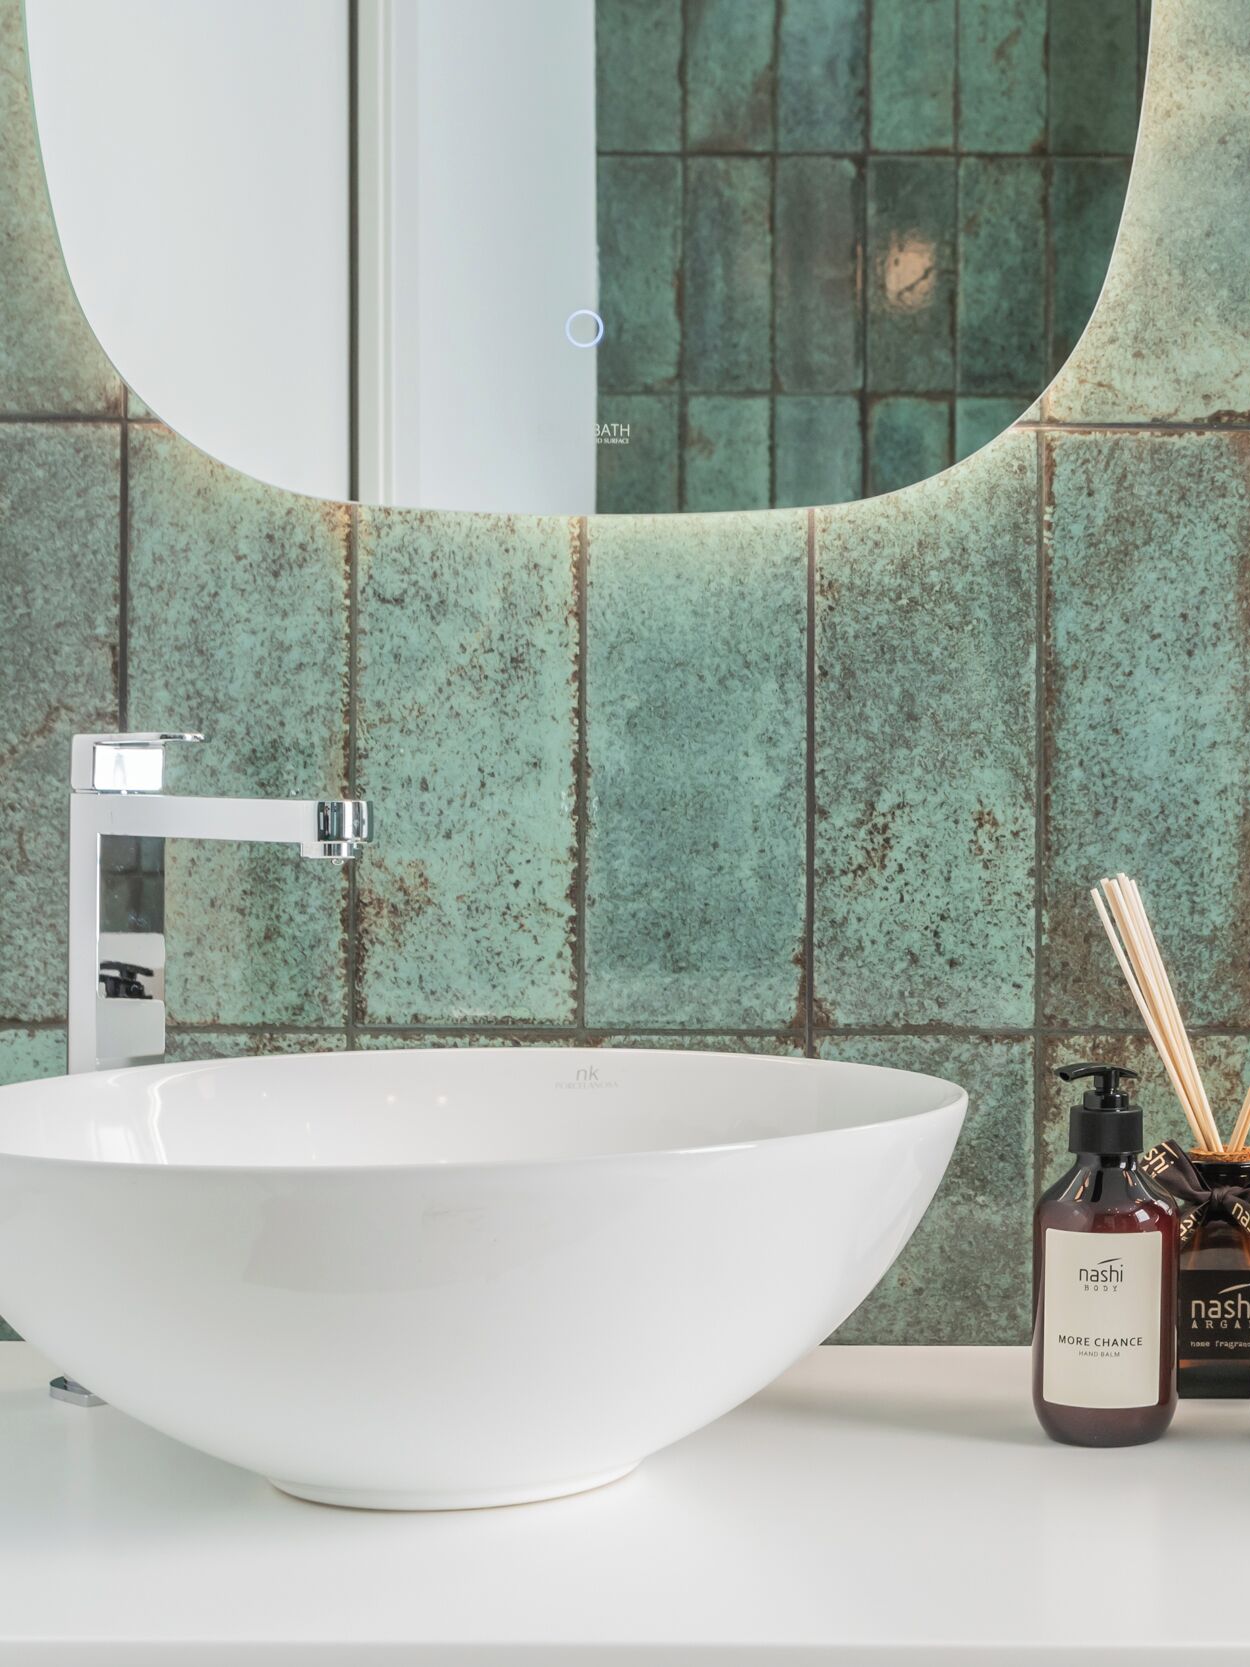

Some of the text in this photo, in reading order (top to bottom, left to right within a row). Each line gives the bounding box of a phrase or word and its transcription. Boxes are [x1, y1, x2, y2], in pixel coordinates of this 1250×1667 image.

[593, 423, 630, 437] BATH
[575, 1064, 600, 1081] nk
[1143, 1147, 1175, 1175] shi
[1079, 1263, 1124, 1283] nashi
[1084, 1284, 1118, 1292] BODY
[1058, 1334, 1143, 1347] MORE CHANCE
